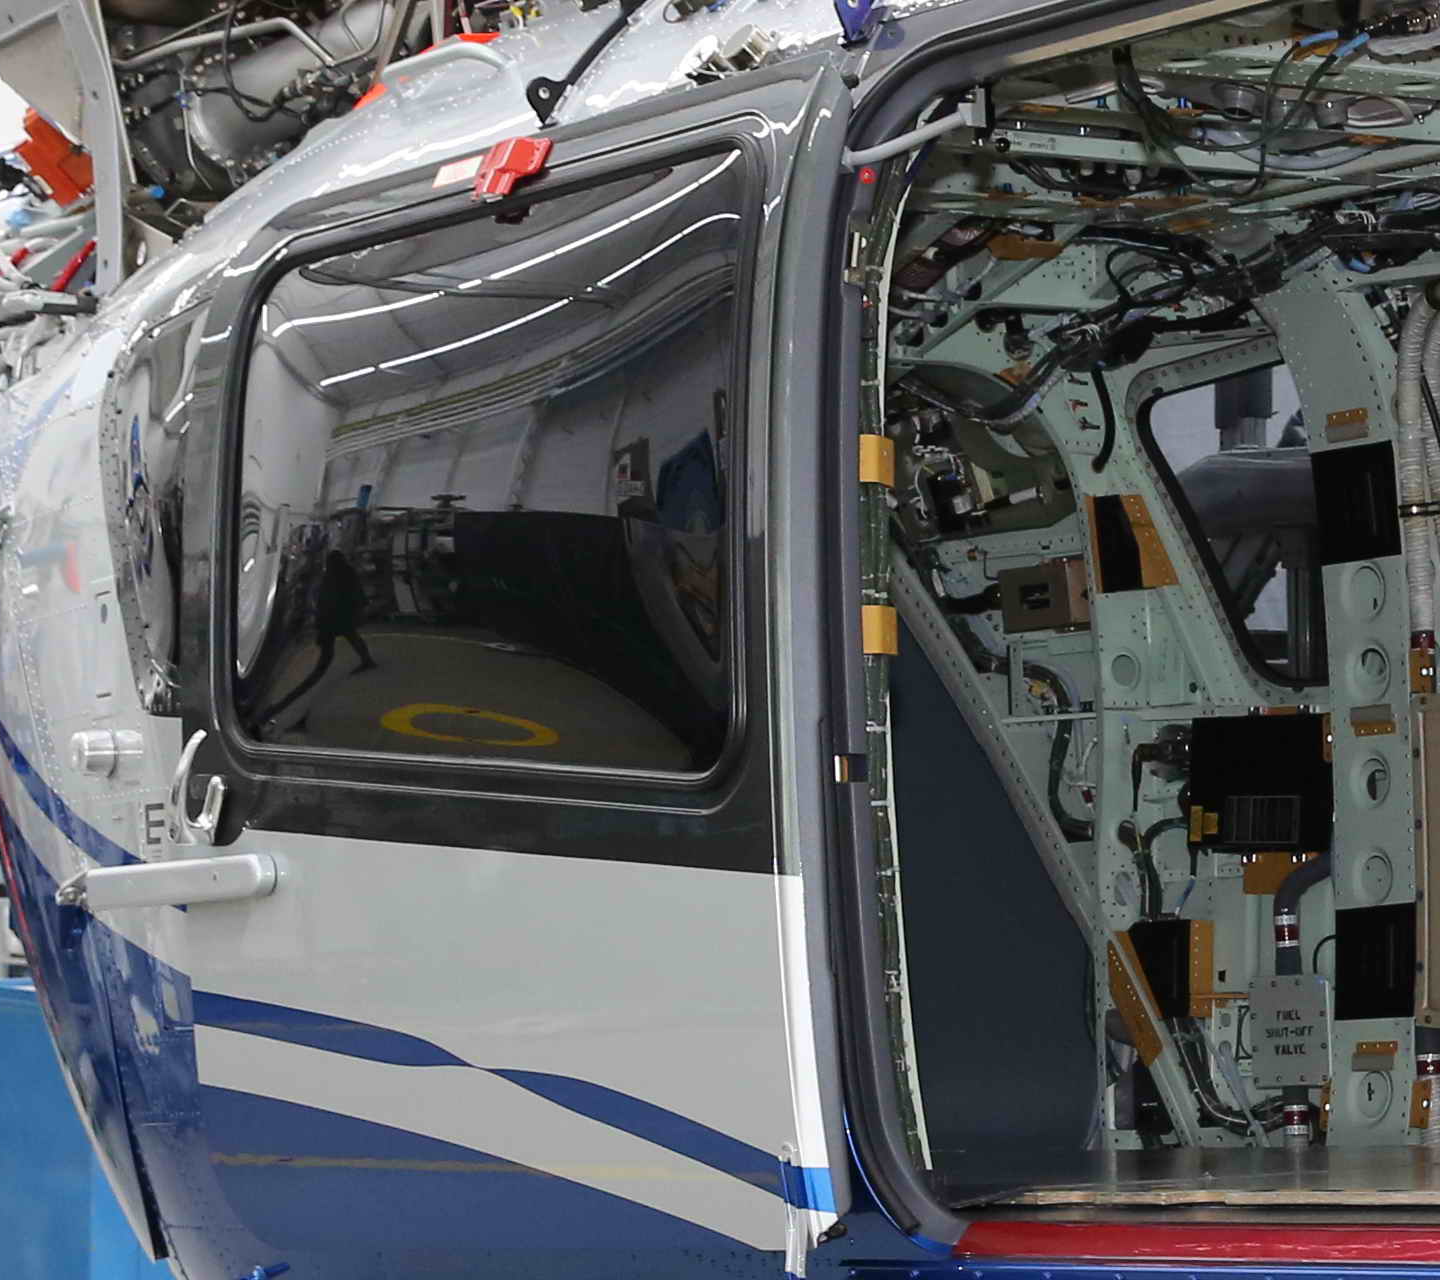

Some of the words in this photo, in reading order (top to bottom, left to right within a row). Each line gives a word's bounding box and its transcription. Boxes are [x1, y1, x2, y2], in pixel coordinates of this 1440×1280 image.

[1276, 1009, 1301, 1022] FUEL
[1265, 1025, 1314, 1039] SHUT-OFF
[1274, 1043, 1306, 1057] VALVE
